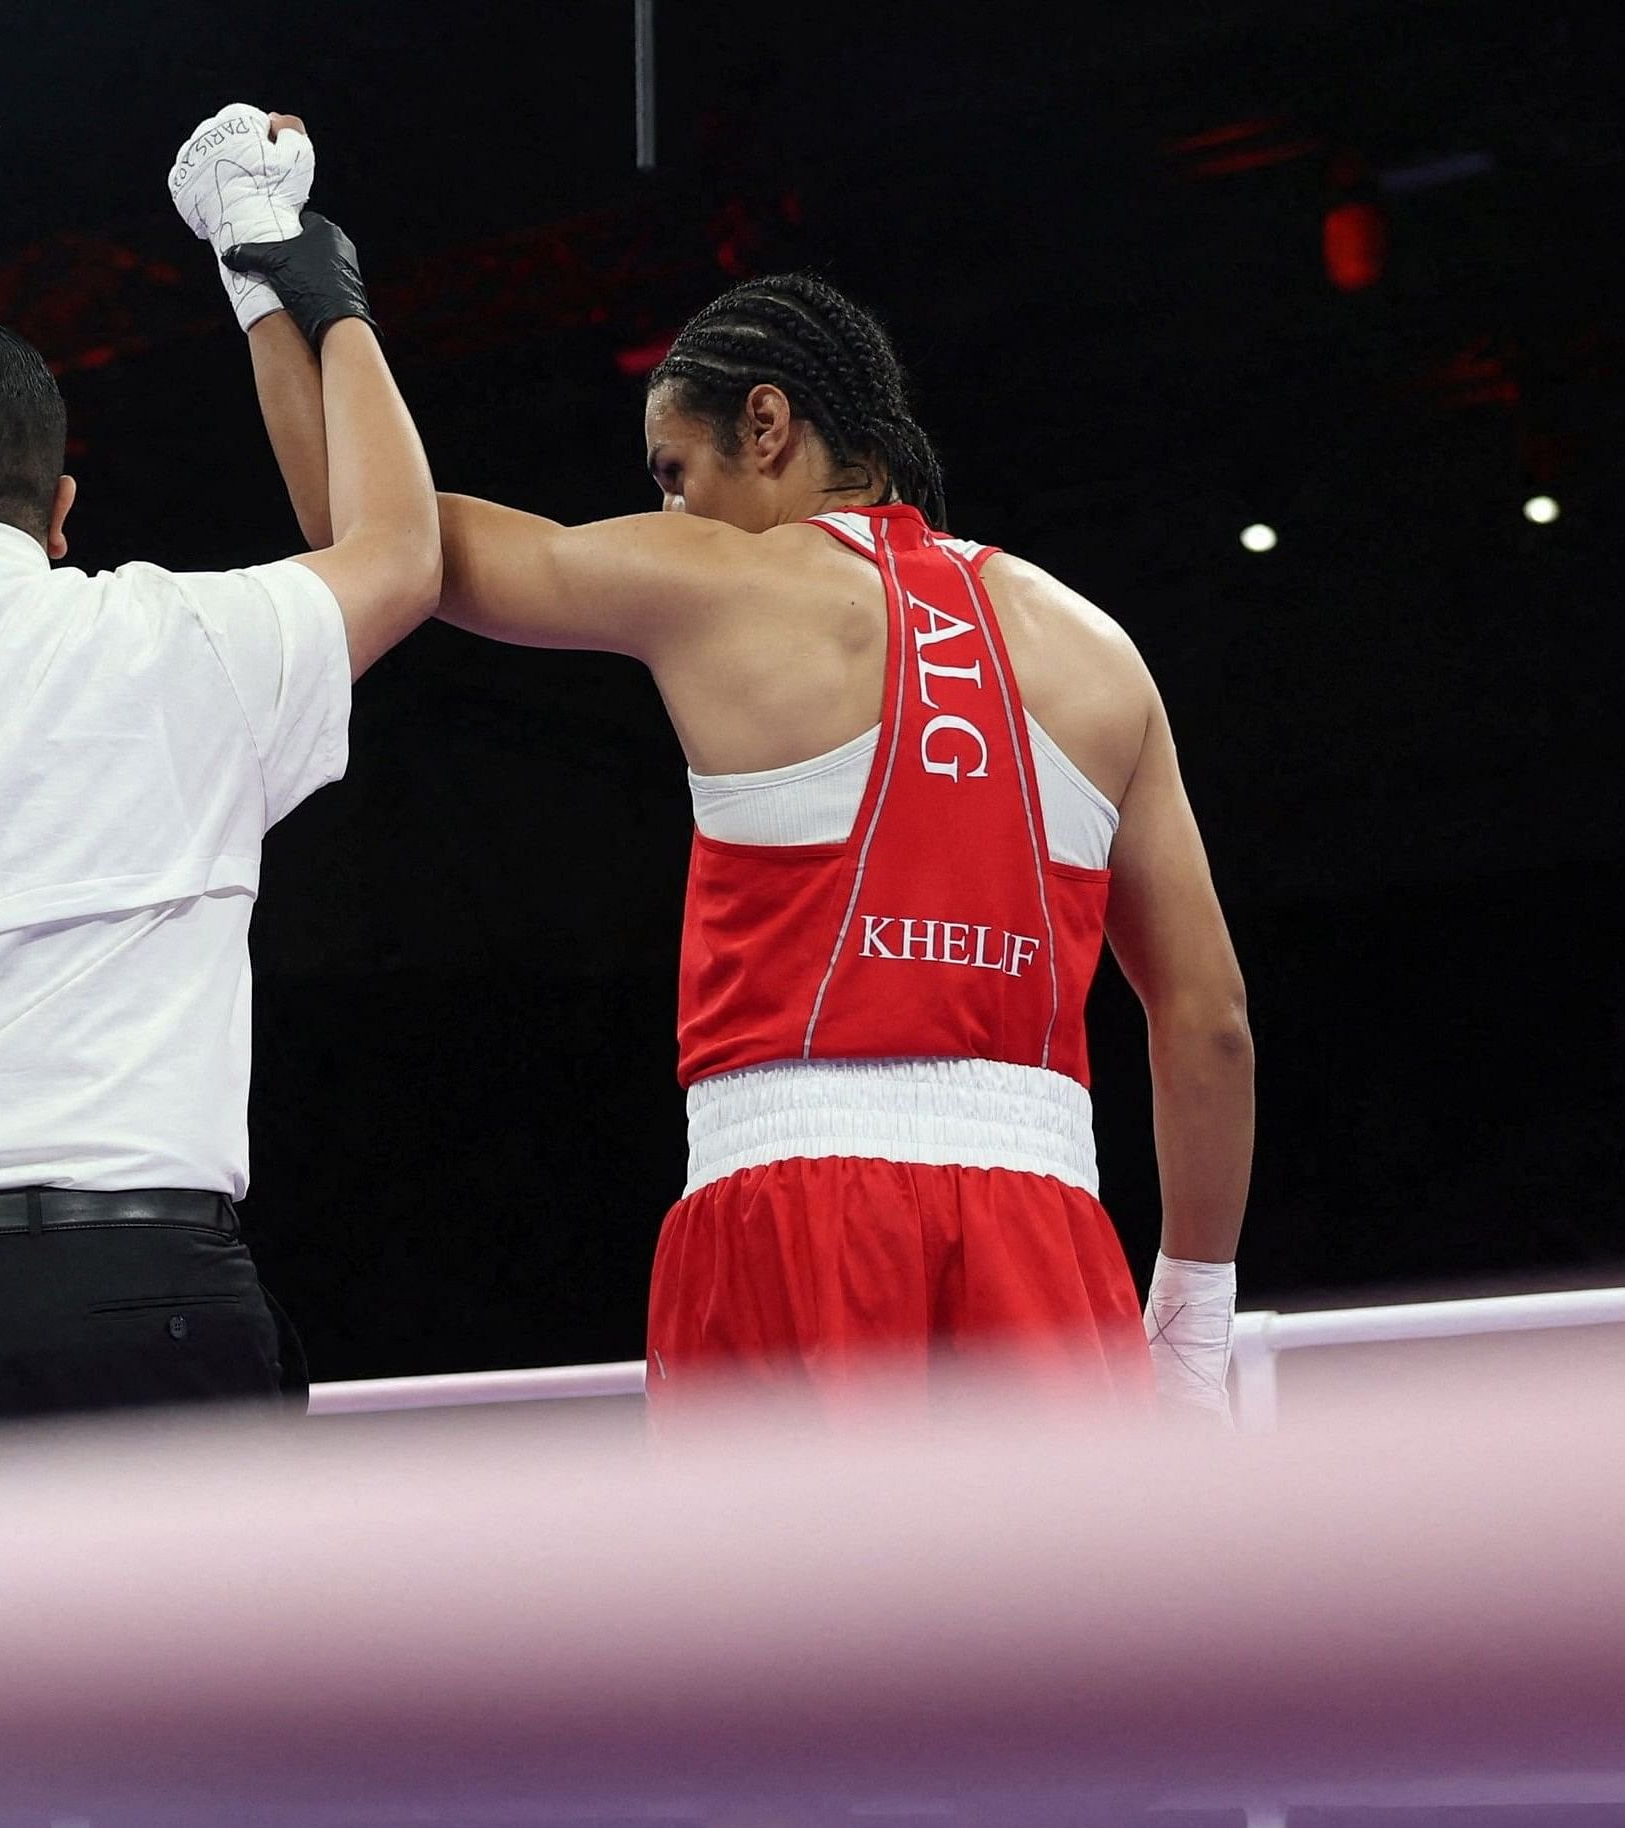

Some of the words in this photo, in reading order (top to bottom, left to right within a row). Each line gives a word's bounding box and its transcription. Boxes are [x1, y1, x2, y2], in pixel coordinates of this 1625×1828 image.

[194, 116, 251, 157] PARIS
[905, 590, 989, 784] ALG
[858, 914, 1041, 978] KHELIF
